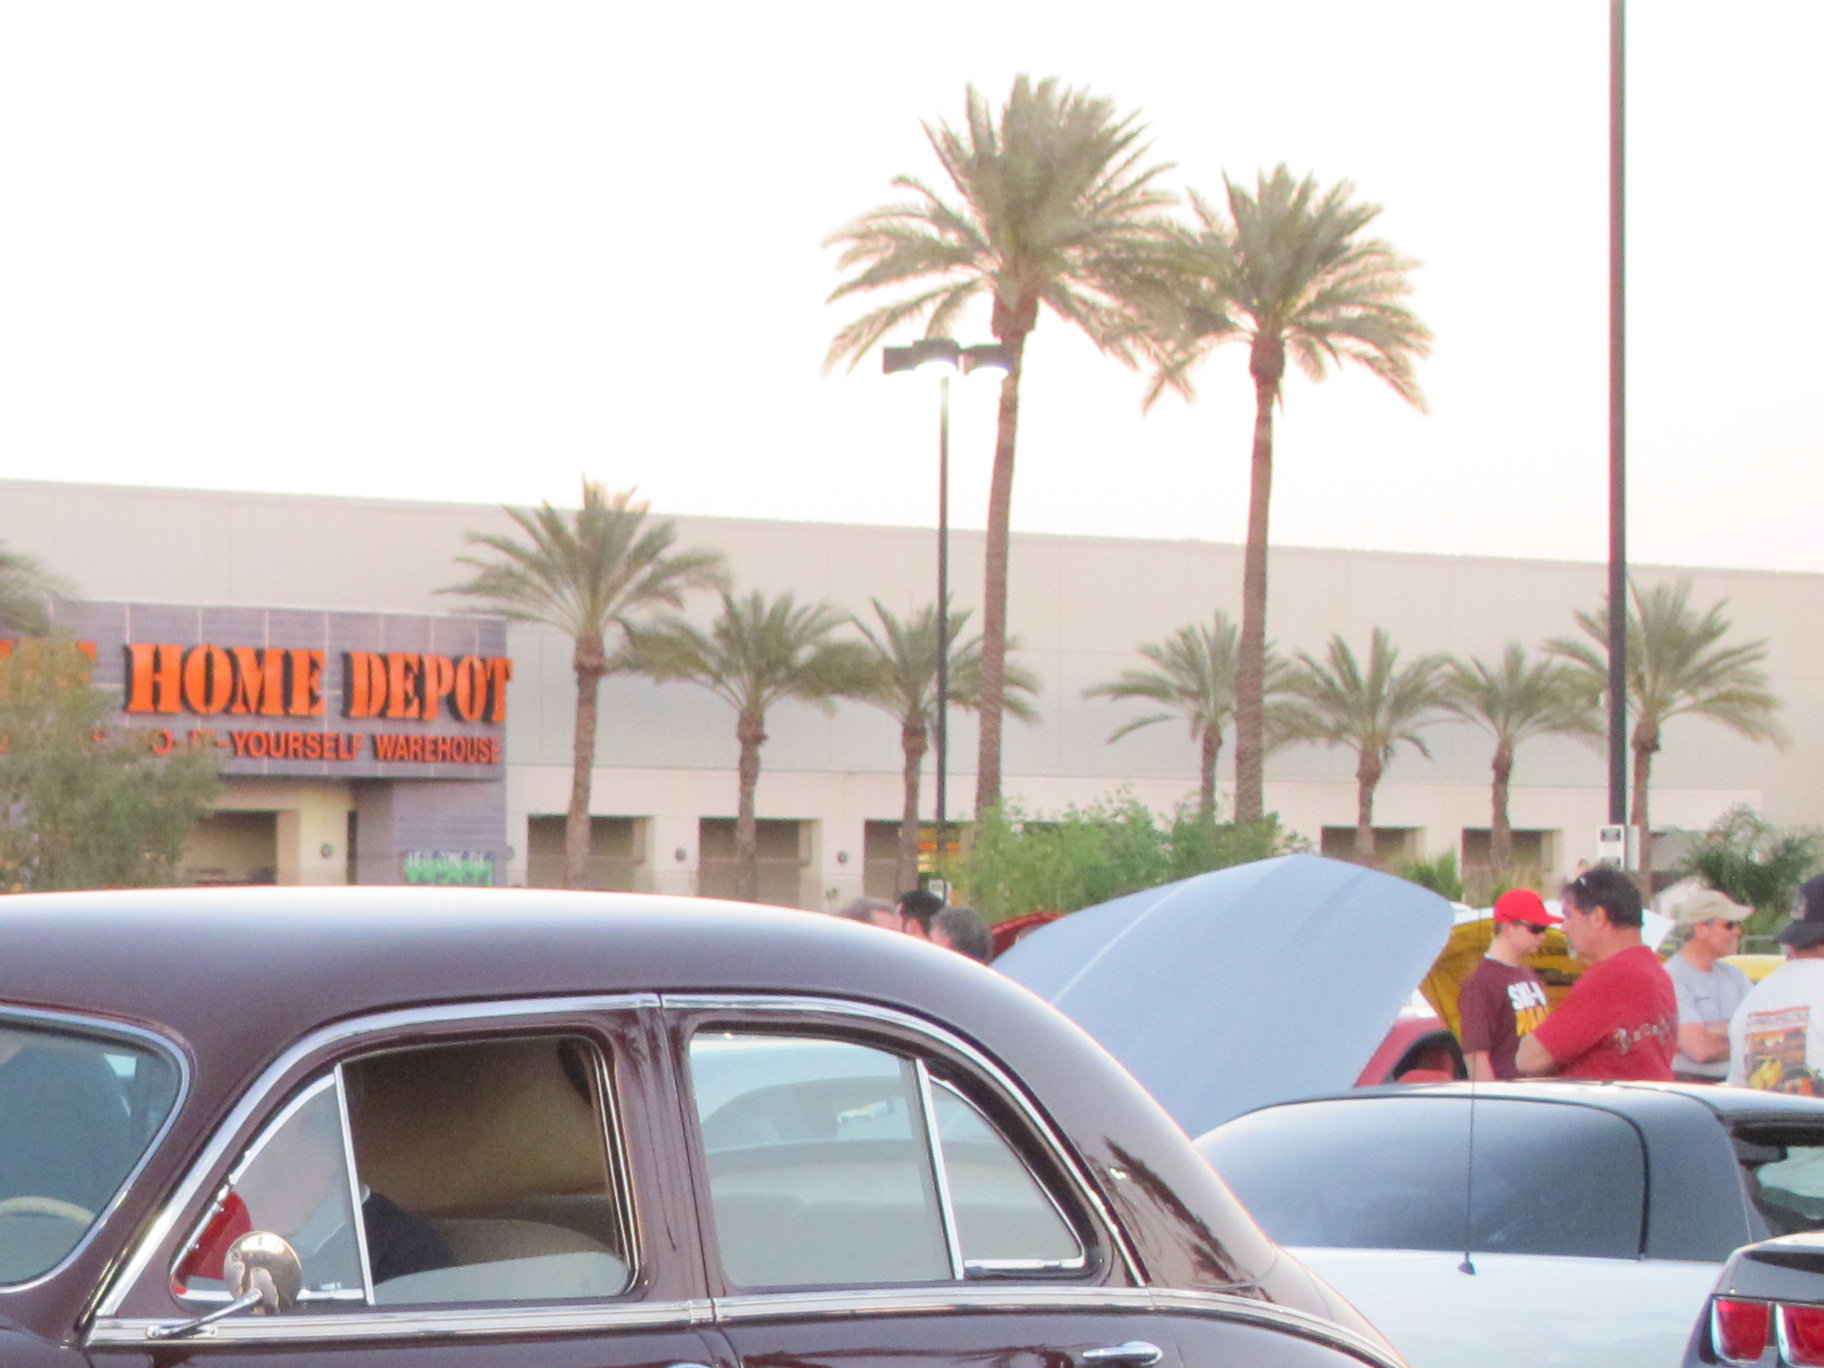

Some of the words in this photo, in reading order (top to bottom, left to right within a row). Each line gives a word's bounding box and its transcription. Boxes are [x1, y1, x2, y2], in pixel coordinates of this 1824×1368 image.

[124, 642, 325, 716] HOME
[342, 650, 514, 723] DEPOT
[372, 733, 502, 764] WAREHOUSE
